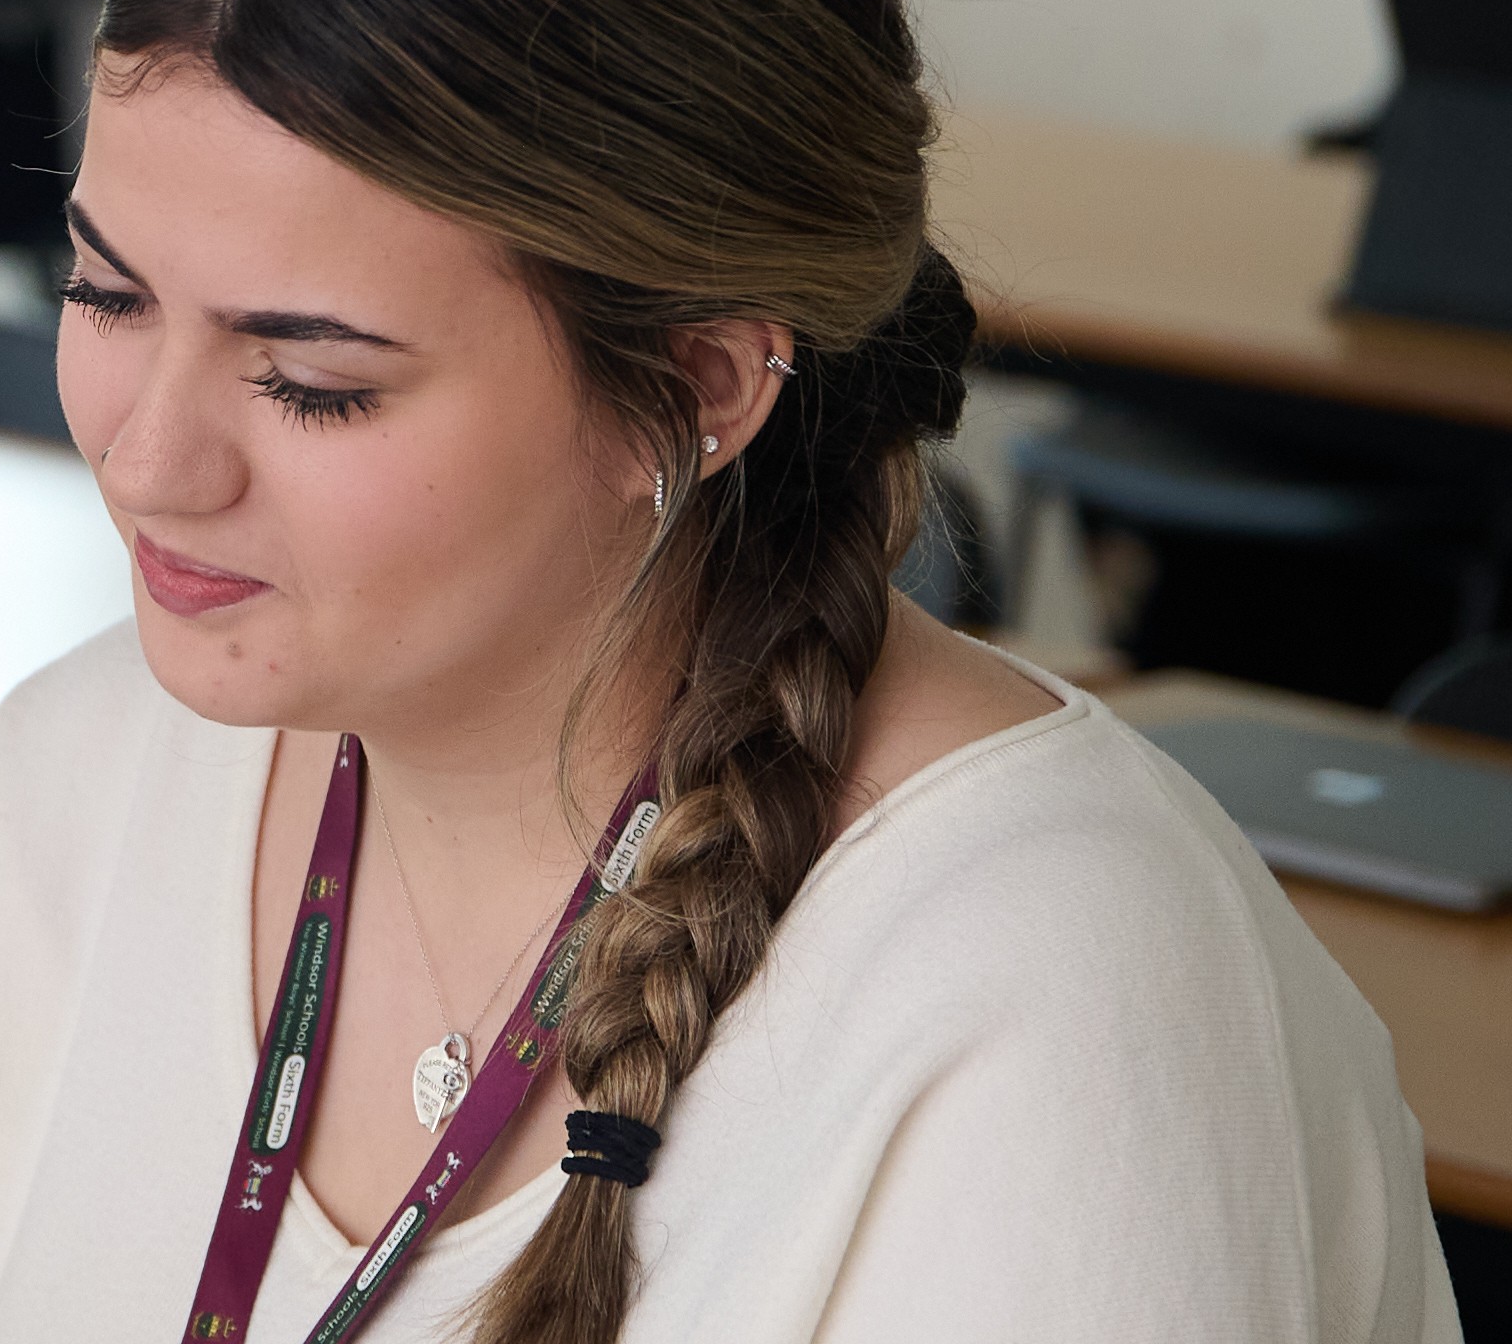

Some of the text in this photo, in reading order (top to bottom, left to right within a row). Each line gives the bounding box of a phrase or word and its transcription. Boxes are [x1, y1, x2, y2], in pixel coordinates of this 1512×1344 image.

[534, 949, 577, 1013] Windsor
[625, 807, 656, 846] Form
[271, 921, 329, 1143] Windsor Schools Sixth Form
[317, 1291, 359, 1344] Schools
[360, 1251, 387, 1283] Sixth
[387, 1212, 415, 1248] Form
